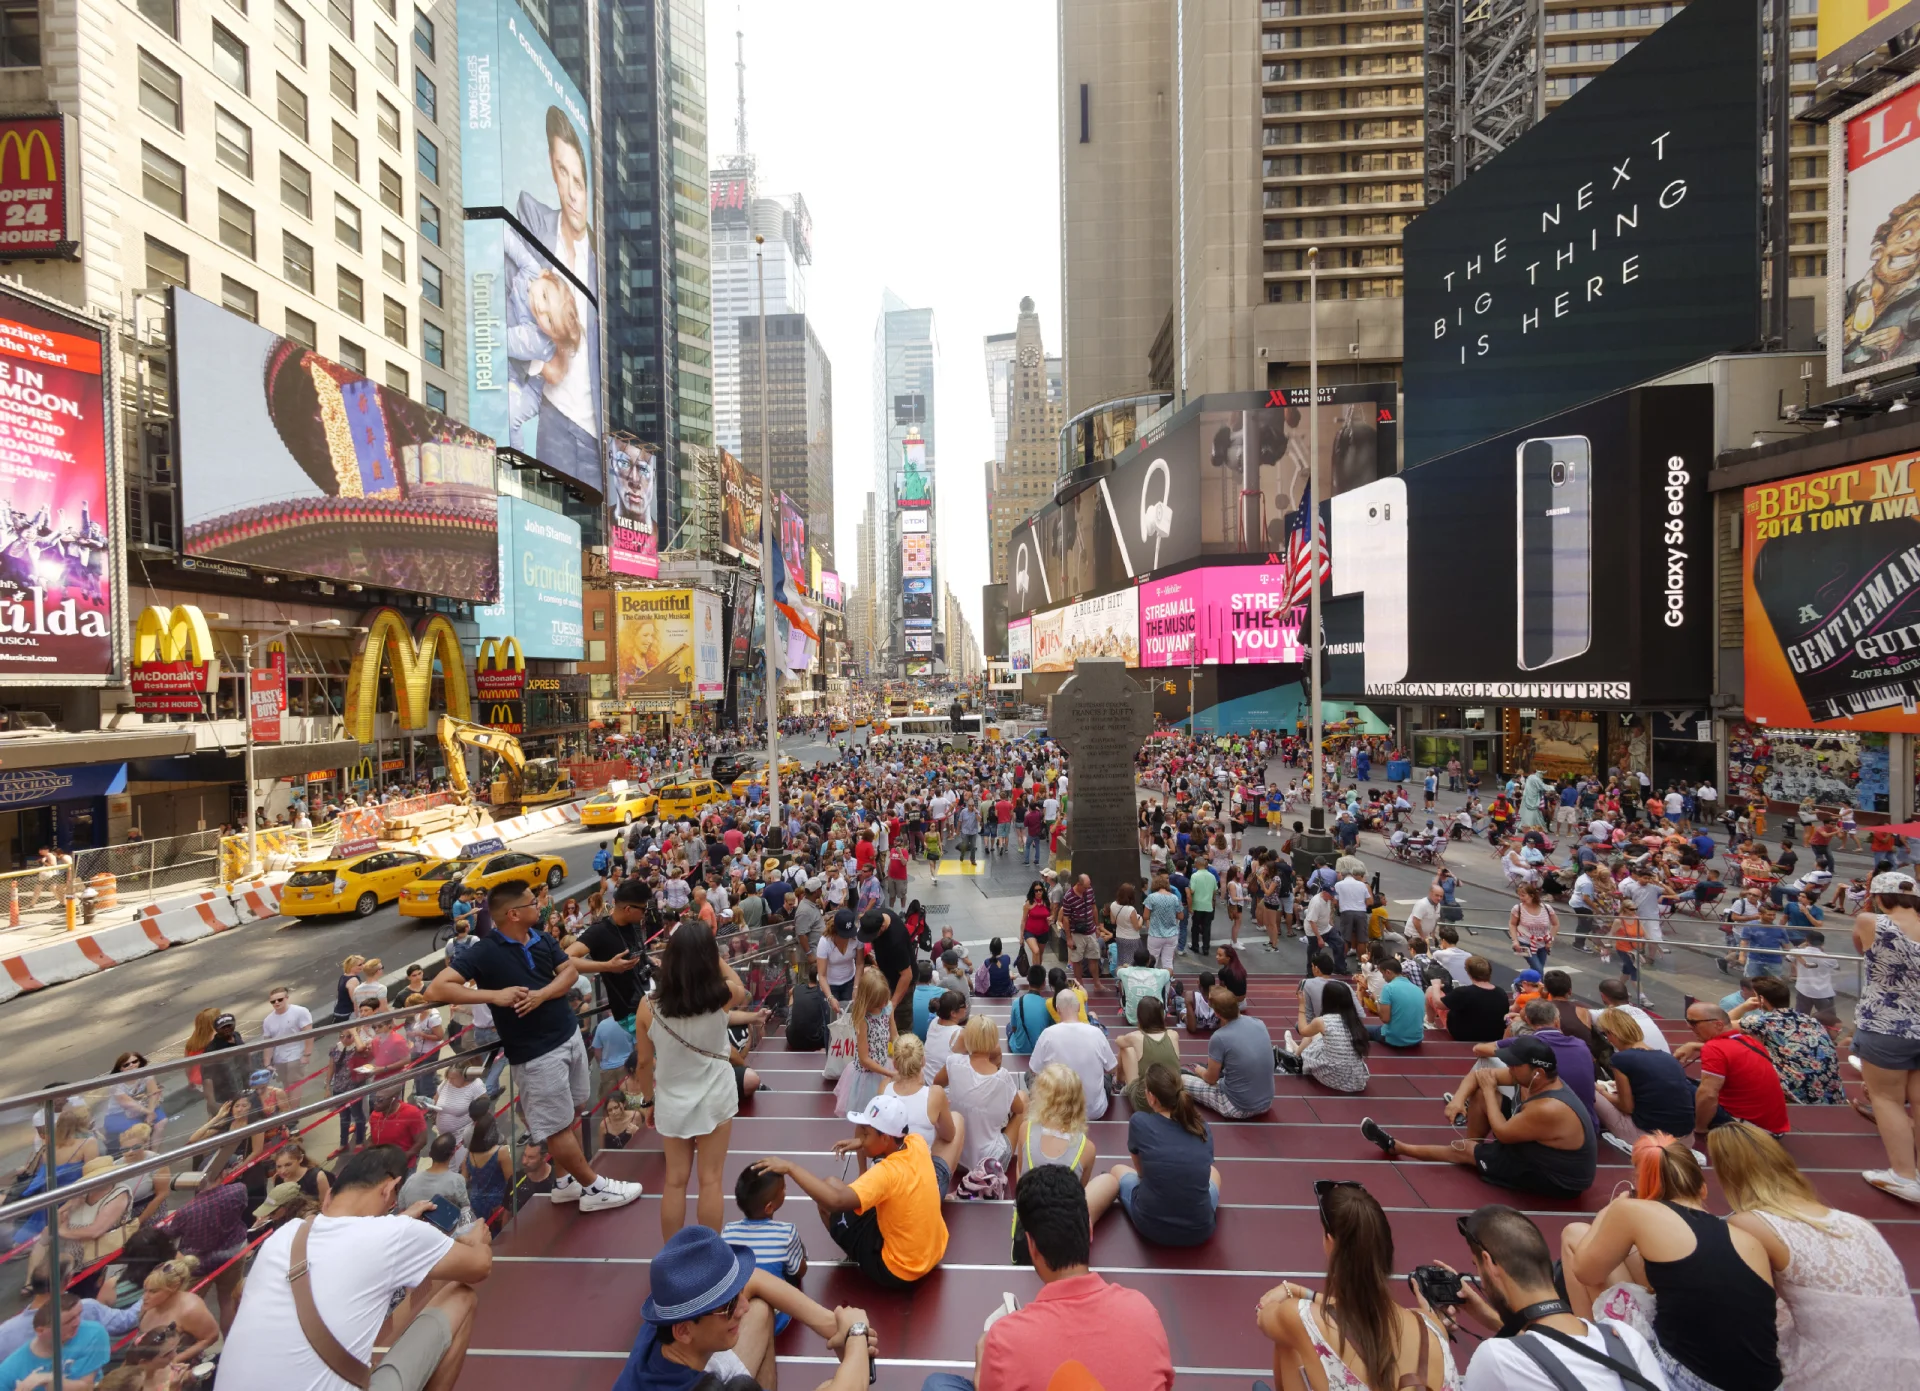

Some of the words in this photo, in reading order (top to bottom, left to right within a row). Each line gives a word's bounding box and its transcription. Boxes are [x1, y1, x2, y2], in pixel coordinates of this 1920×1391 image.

[509, 17, 517, 37] A
[518, 32, 553, 88] coming
[554, 81, 564, 99] of
[467, 55, 478, 83] SEPT
[478, 54, 491, 130] TUESDAYS
[0, 187, 53, 202] OPEN
[5, 203, 48, 227] 24
[1443, 237, 1507, 292] THE
[1542, 131, 1670, 233] NEXT
[1434, 292, 1492, 340] BIG
[1525, 179, 1687, 286] THING
[1460, 334, 1490, 364] IS
[1522, 254, 1639, 334] HERE
[473, 270, 501, 391] Grandfathered
[0, 337, 25, 353] the
[27, 343, 68, 365] Year!
[15, 366, 43, 390] IN
[1291, 387, 1337, 396] MAROTT
[1291, 395, 1332, 404] MARUIS
[12, 426, 56, 447] YOUR
[30, 420, 65, 436] AND
[1664, 455, 1690, 515] edge
[1756, 470, 1860, 521] BEST
[1869, 457, 1920, 500] M
[1545, 506, 1570, 517] SAMSUNG
[524, 519, 545, 536] John
[546, 525, 572, 545] Stamos
[617, 516, 632, 529] TAYE
[633, 520, 652, 535] DIGGS
[1664, 519, 1684, 545] S6
[1756, 515, 1803, 540] 2014
[1808, 504, 1864, 532] TONY
[1664, 548, 1688, 627] Galaxy
[622, 595, 690, 612] Beautiful
[1080, 602, 1091, 615] BIG
[1092, 596, 1105, 613] FAT
[1145, 600, 1177, 621] STREAM
[1177, 597, 1196, 613] ALL
[1231, 592, 1280, 610] STRE
[654, 613, 667, 621] King
[1798, 603, 1823, 625] A
[1146, 620, 1163, 637] THE
[1164, 614, 1196, 635] MUSIC
[1146, 637, 1165, 654] YOU
[1165, 633, 1196, 653] WANT
[1232, 629, 1279, 649] YOU
[1326, 641, 1365, 655] AMSUN
[133, 671, 204, 682] McDonald's
[526, 679, 560, 690] XPRESS
[1851, 669, 1882, 680] LOVE
[251, 689, 280, 705] JERSEY
[1365, 683, 1437, 697] AMERICAN
[1442, 682, 1493, 697] EAGLE
[1497, 682, 1629, 699] OUTFITTERS
[257, 702, 279, 718] BOYS
[1110, 708, 1135, 716] DUFFY
[3, 776, 73, 791] EXCHANGE
[831, 1039, 855, 1058] H&M
[1539, 1302, 1562, 1312] LUMIX
